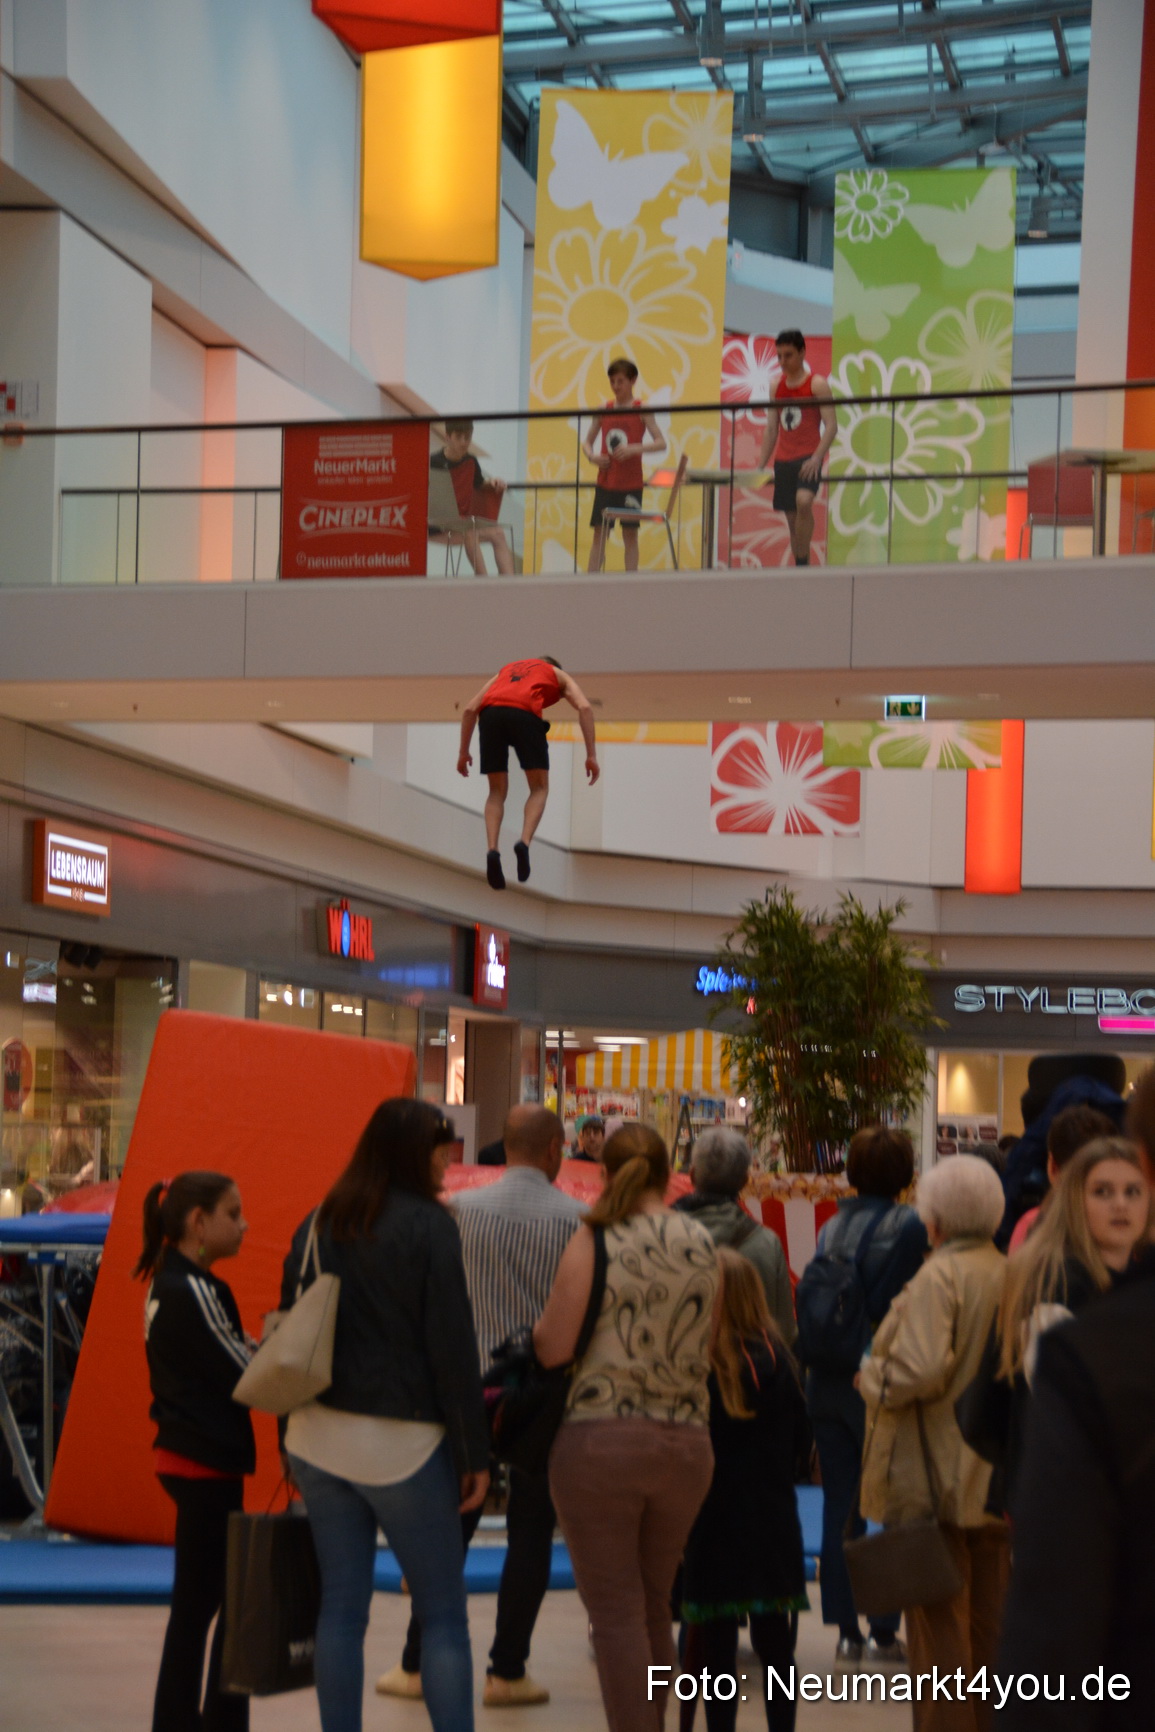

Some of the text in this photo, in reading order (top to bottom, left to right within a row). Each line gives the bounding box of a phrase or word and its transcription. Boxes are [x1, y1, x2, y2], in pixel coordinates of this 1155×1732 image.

[314, 457, 397, 475] NeuerMarkt
[299, 504, 409, 532] CINEPLEX
[51, 848, 105, 890] LEBENSRAUM
[954, 984, 1155, 1015] STYLEBO
